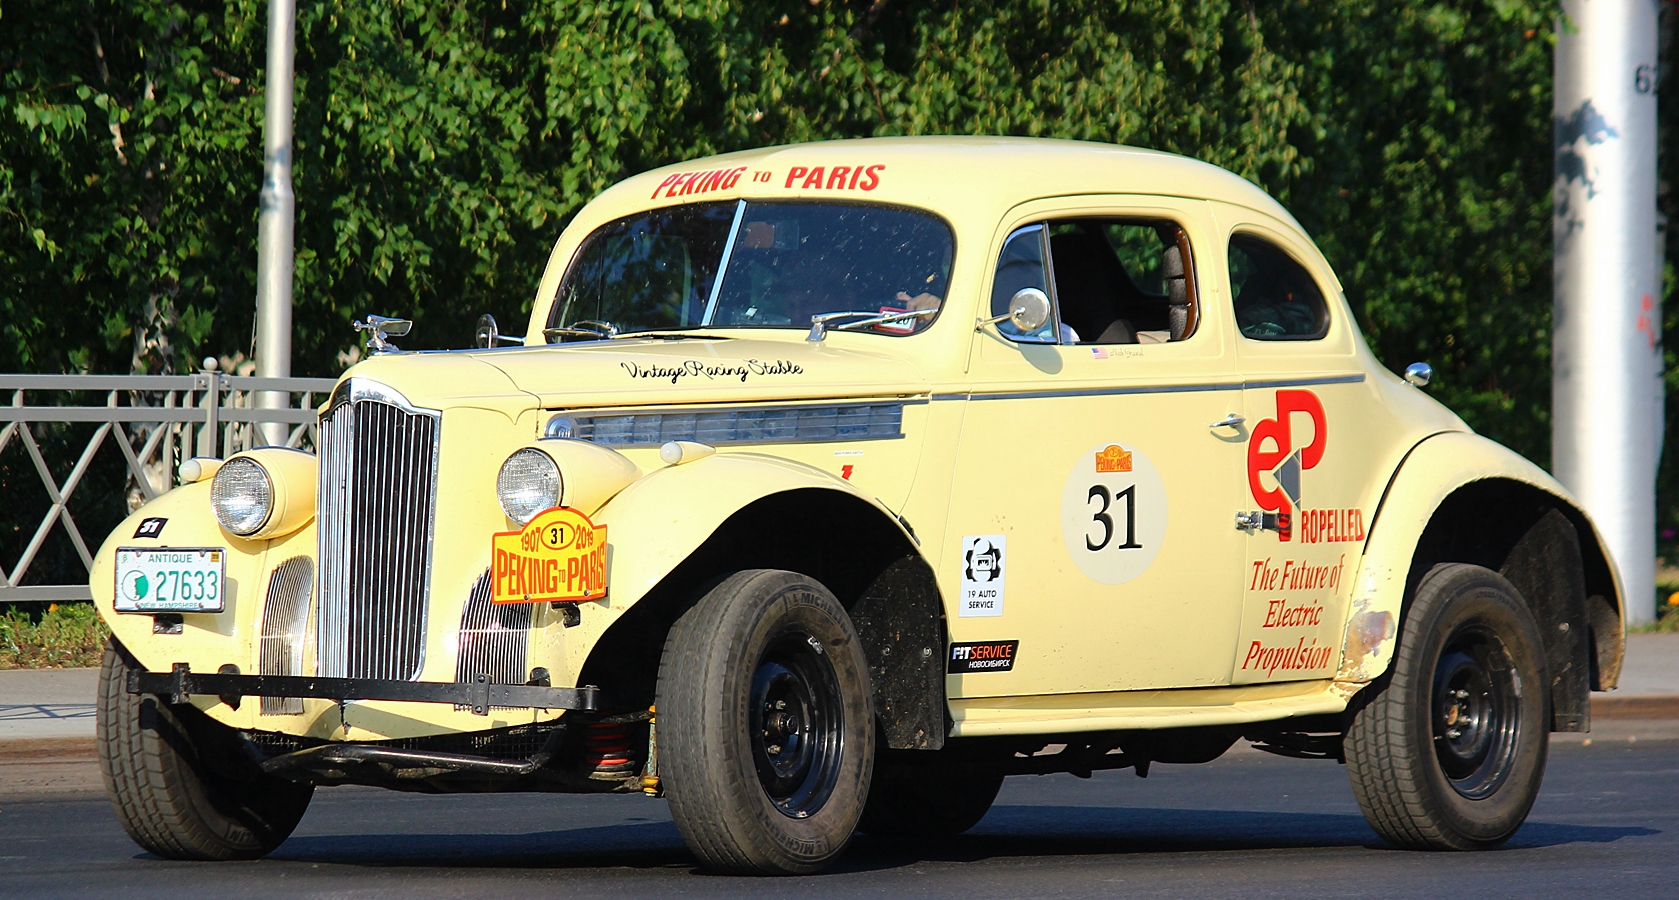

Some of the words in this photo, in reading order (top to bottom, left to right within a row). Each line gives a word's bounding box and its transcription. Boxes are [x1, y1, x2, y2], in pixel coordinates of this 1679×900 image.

[650, 166, 748, 200] PEKING
[752, 171, 772, 183] TO
[784, 164, 886, 191] PARIS
[620, 361, 687, 385] Vintage
[683, 360, 749, 382] Racing
[743, 359, 804, 376] Stable
[139, 520, 161, 534] 31
[1086, 484, 1143, 551] 31
[1301, 508, 1366, 544] ROPELLED
[521, 526, 541, 552] 1907
[550, 527, 564, 544] 31
[575, 524, 593, 550] 2019
[148, 554, 193, 563] ANTIQUE
[496, 547, 558, 596] PEKING
[558, 569, 566, 583] TO
[567, 541, 605, 592] PARIS
[155, 570, 218, 601] 27633
[1250, 556, 1279, 591] The
[1279, 559, 1329, 590] Future
[1329, 553, 1346, 595] of
[967, 590, 976, 598] 19
[978, 590, 997, 598] AUTO
[968, 601, 994, 609] SERVICE
[1262, 598, 1324, 628] Electric
[968, 659, 1011, 668] НОВОСИБИРСК
[1241, 635, 1333, 678] Propulsion
